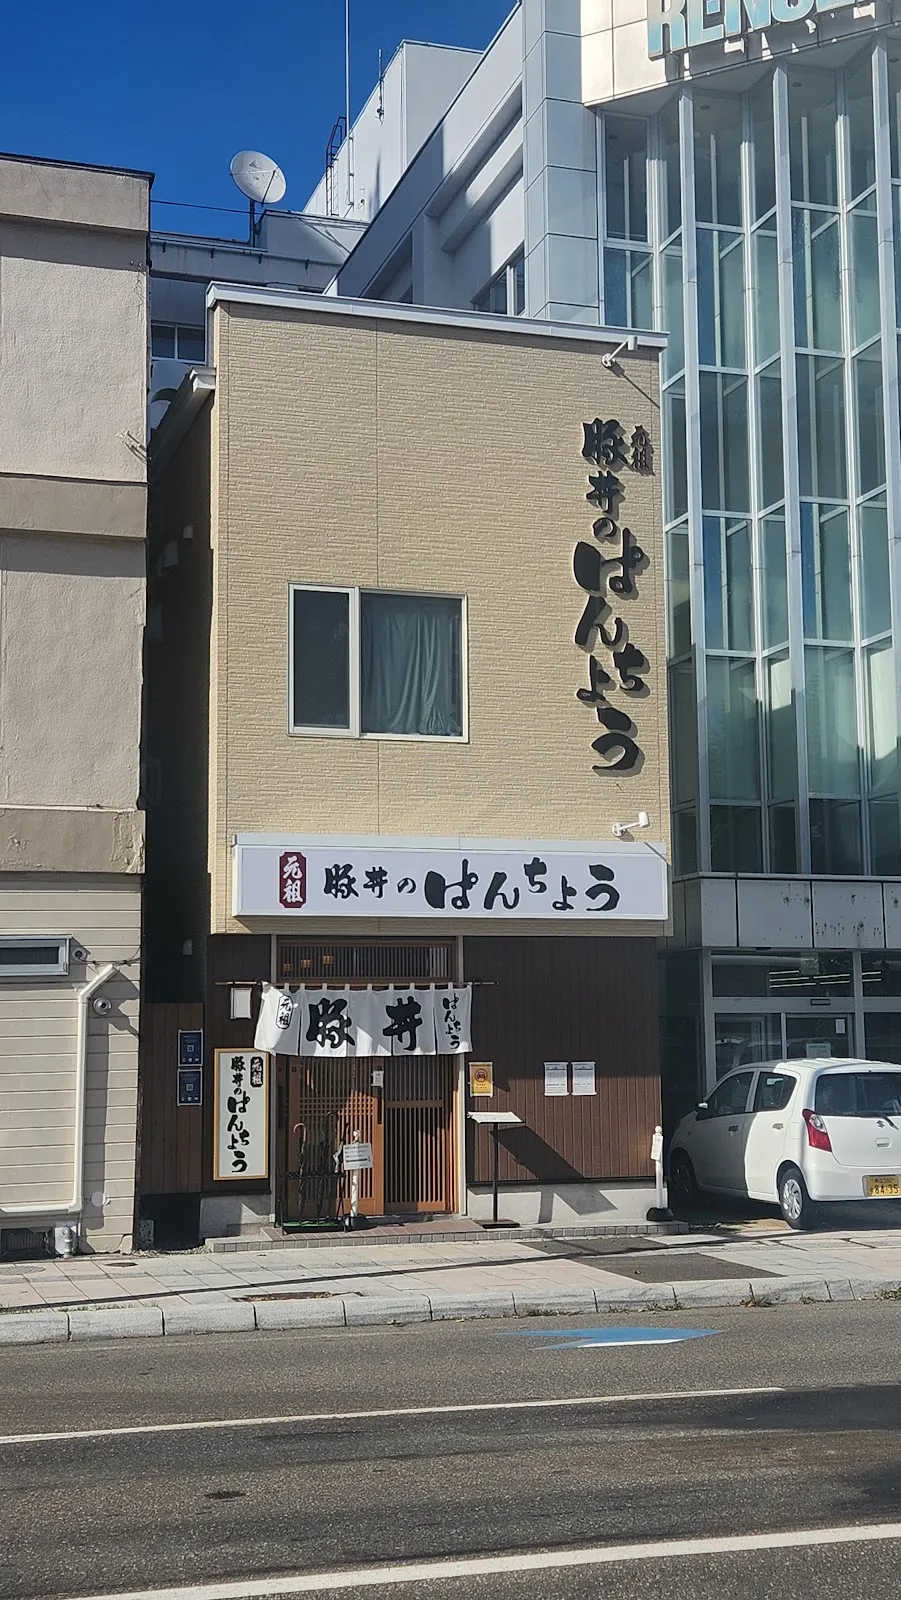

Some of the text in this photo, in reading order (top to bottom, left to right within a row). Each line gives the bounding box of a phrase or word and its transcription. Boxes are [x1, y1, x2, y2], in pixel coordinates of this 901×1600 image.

[282, 855, 303, 903] 元祖
[324, 857, 620, 911] 豚丼のぱんちょう
[279, 998, 291, 1025] 元祖
[442, 993, 462, 1050] ぱんちょう
[251, 1057, 263, 1086] 元祖
[226, 1055, 250, 1173] 豚丼のぱんちょう
